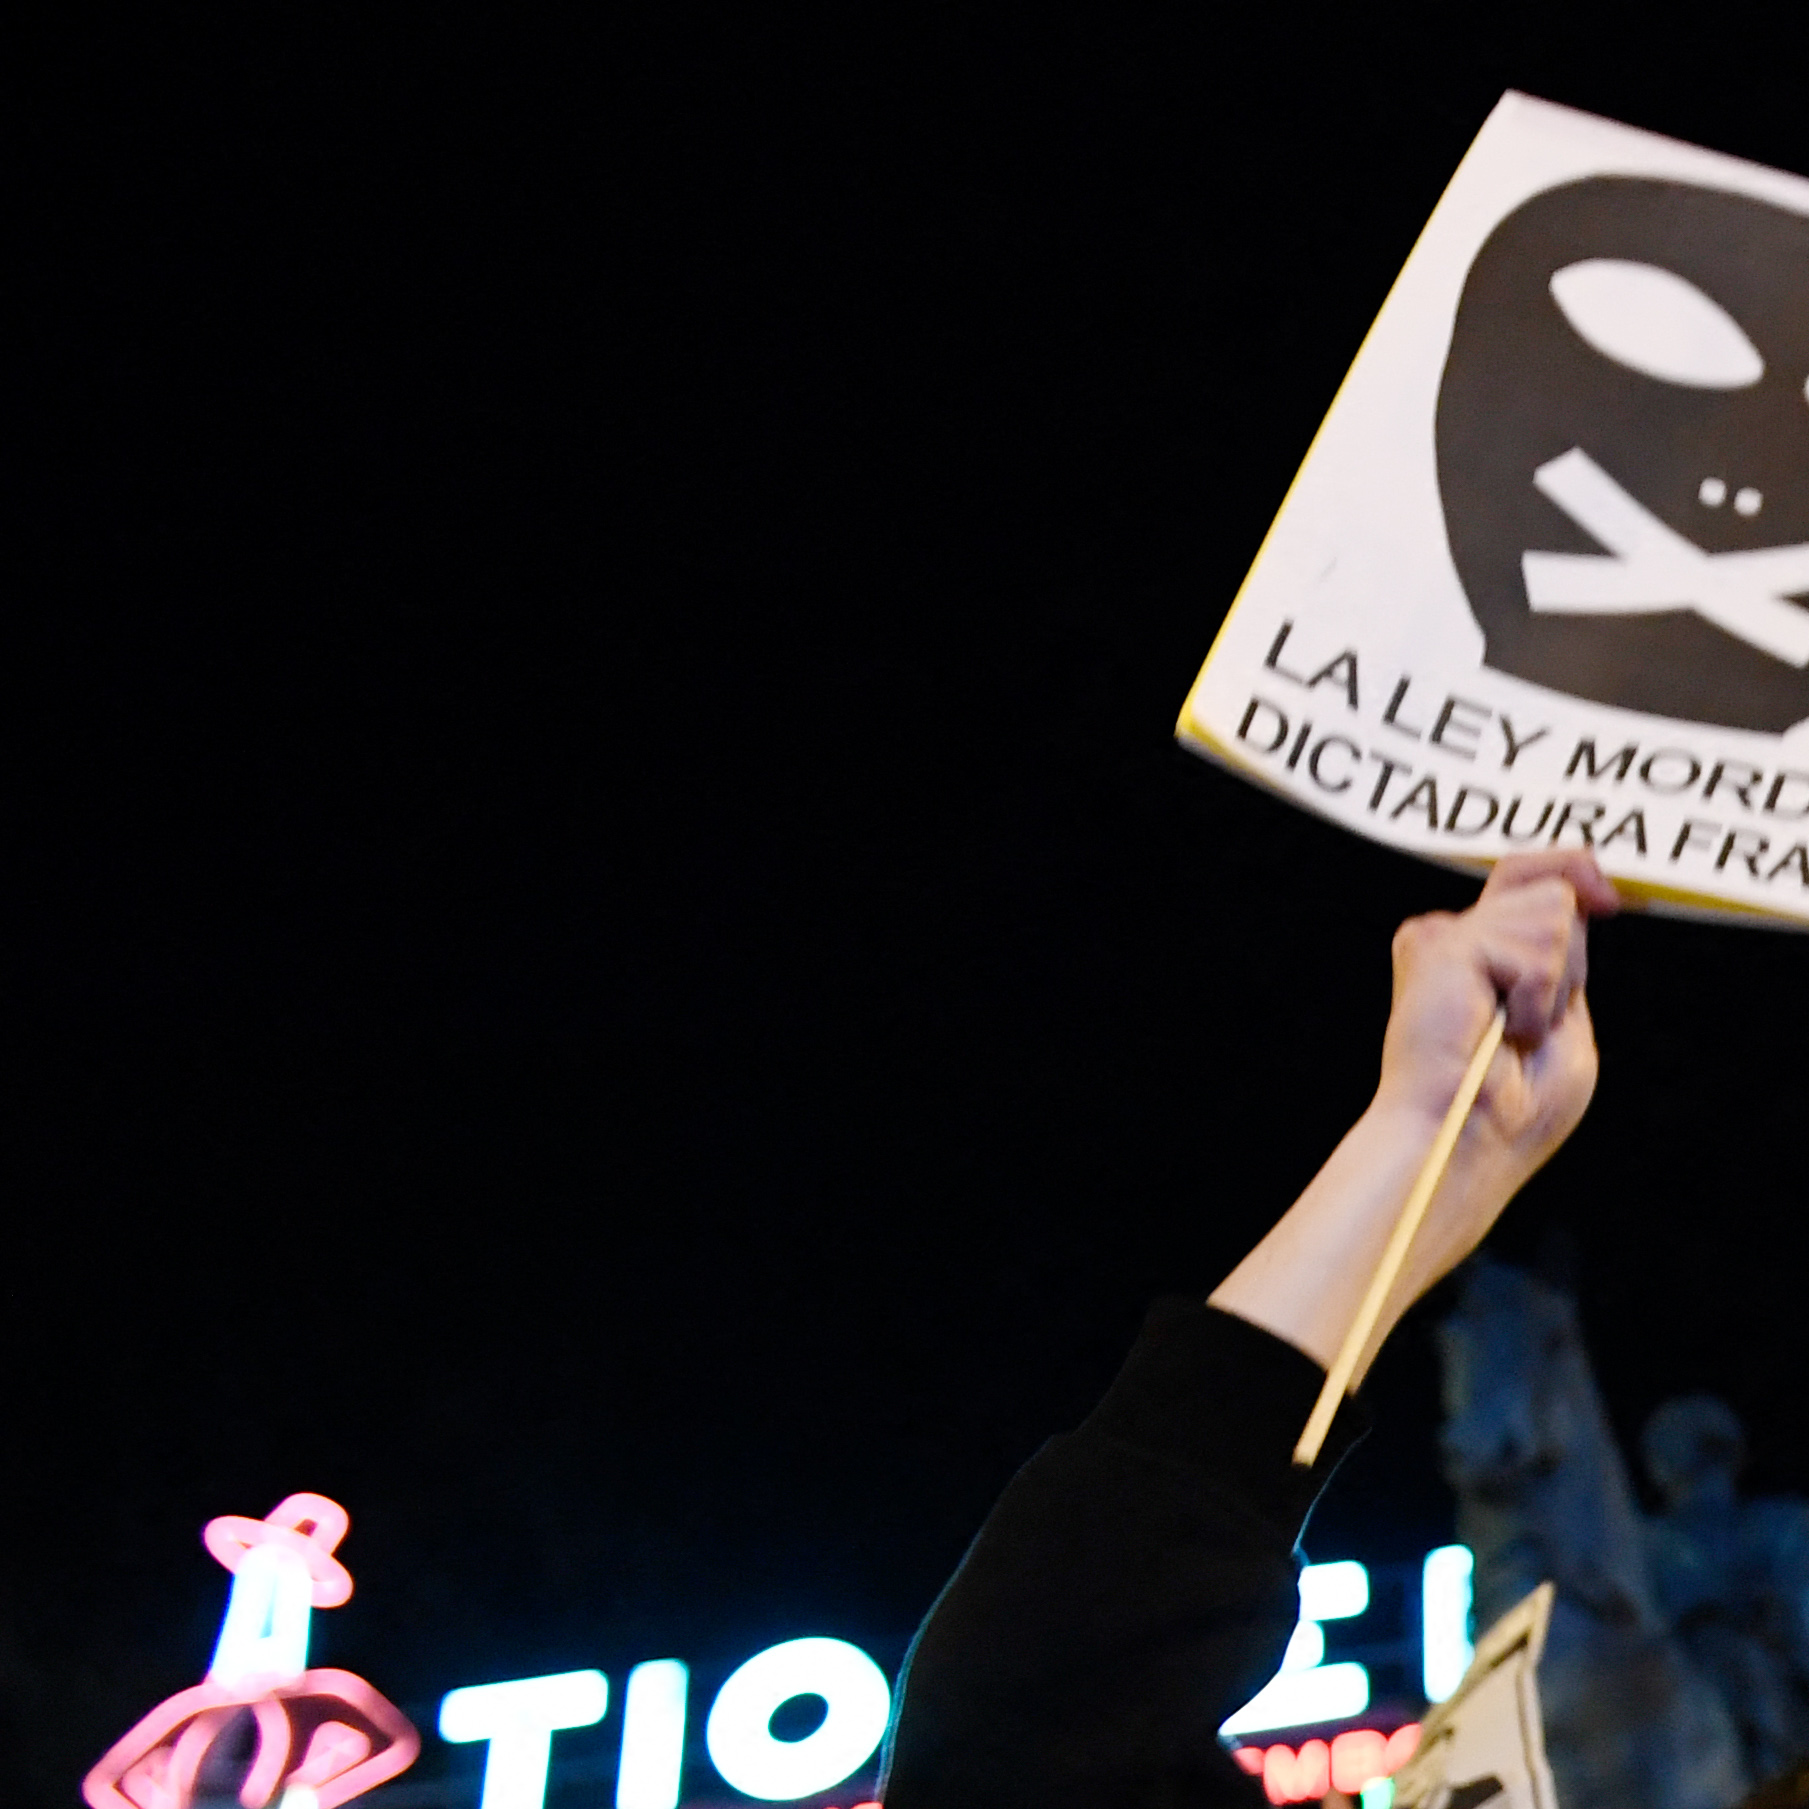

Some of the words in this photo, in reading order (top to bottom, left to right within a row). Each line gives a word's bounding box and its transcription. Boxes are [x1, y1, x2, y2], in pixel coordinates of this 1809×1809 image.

[1263, 618, 1361, 710] LA
[1382, 676, 1551, 770] LEY
[1233, 697, 1650, 858] DICTADURA
